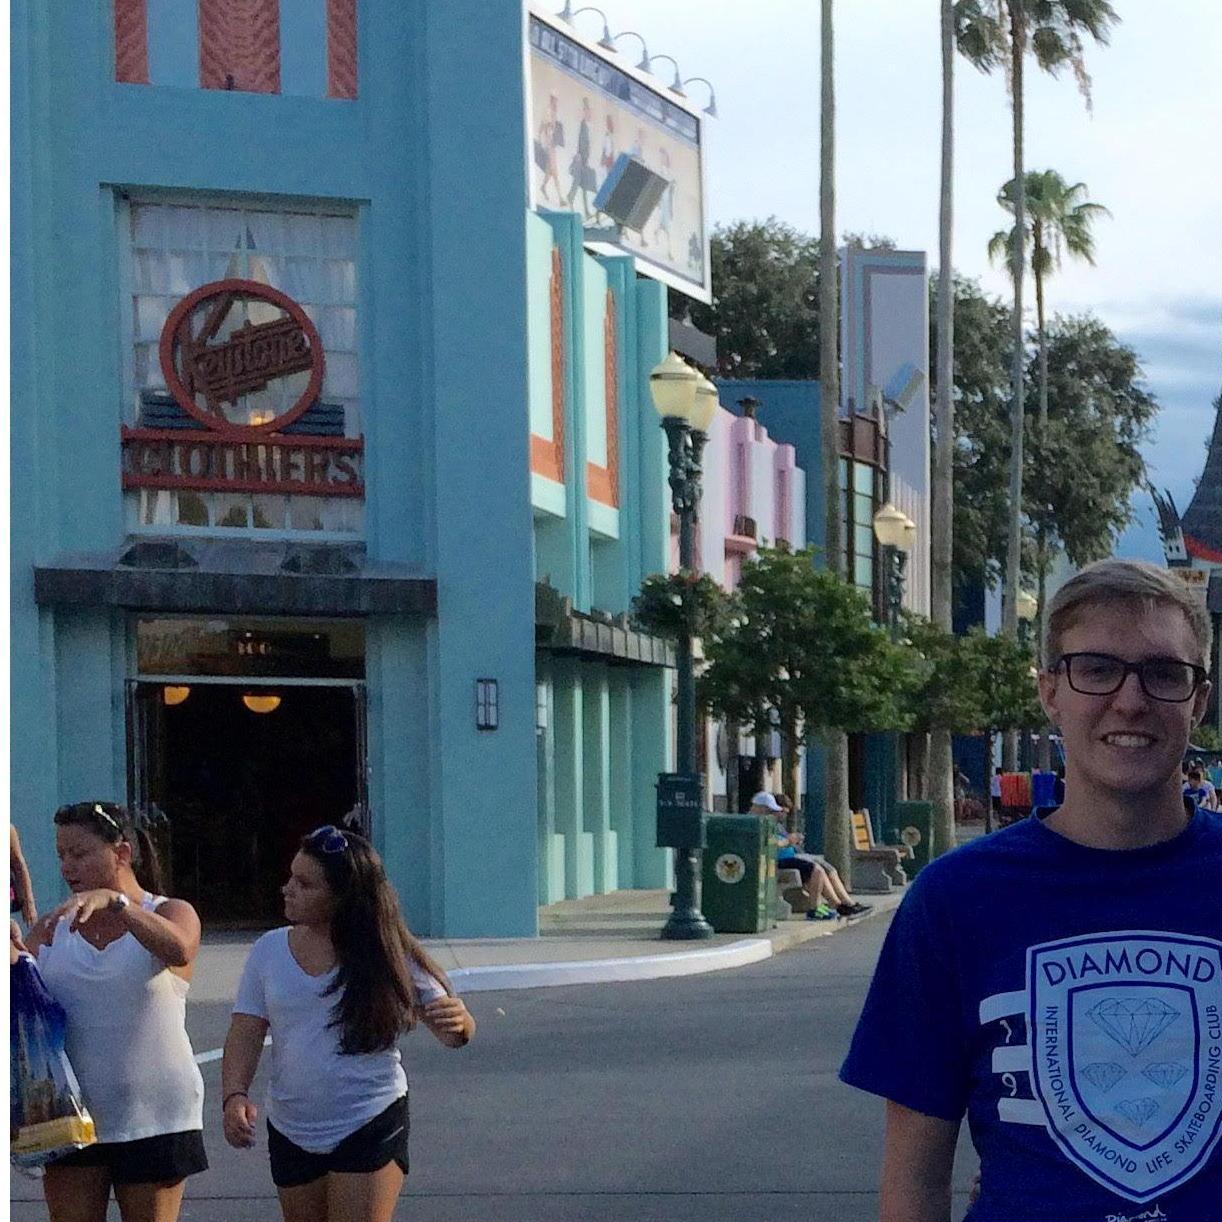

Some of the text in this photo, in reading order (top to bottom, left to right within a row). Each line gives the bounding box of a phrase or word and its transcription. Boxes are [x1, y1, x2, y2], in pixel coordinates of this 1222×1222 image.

[128, 440, 358, 484] CLOTHIERS
[1042, 947, 1216, 987] DIAMOND
[1044, 1004, 1221, 1175] INTERNATIONAL DIAMOND LIFE SKATEBOARDING CLUB
